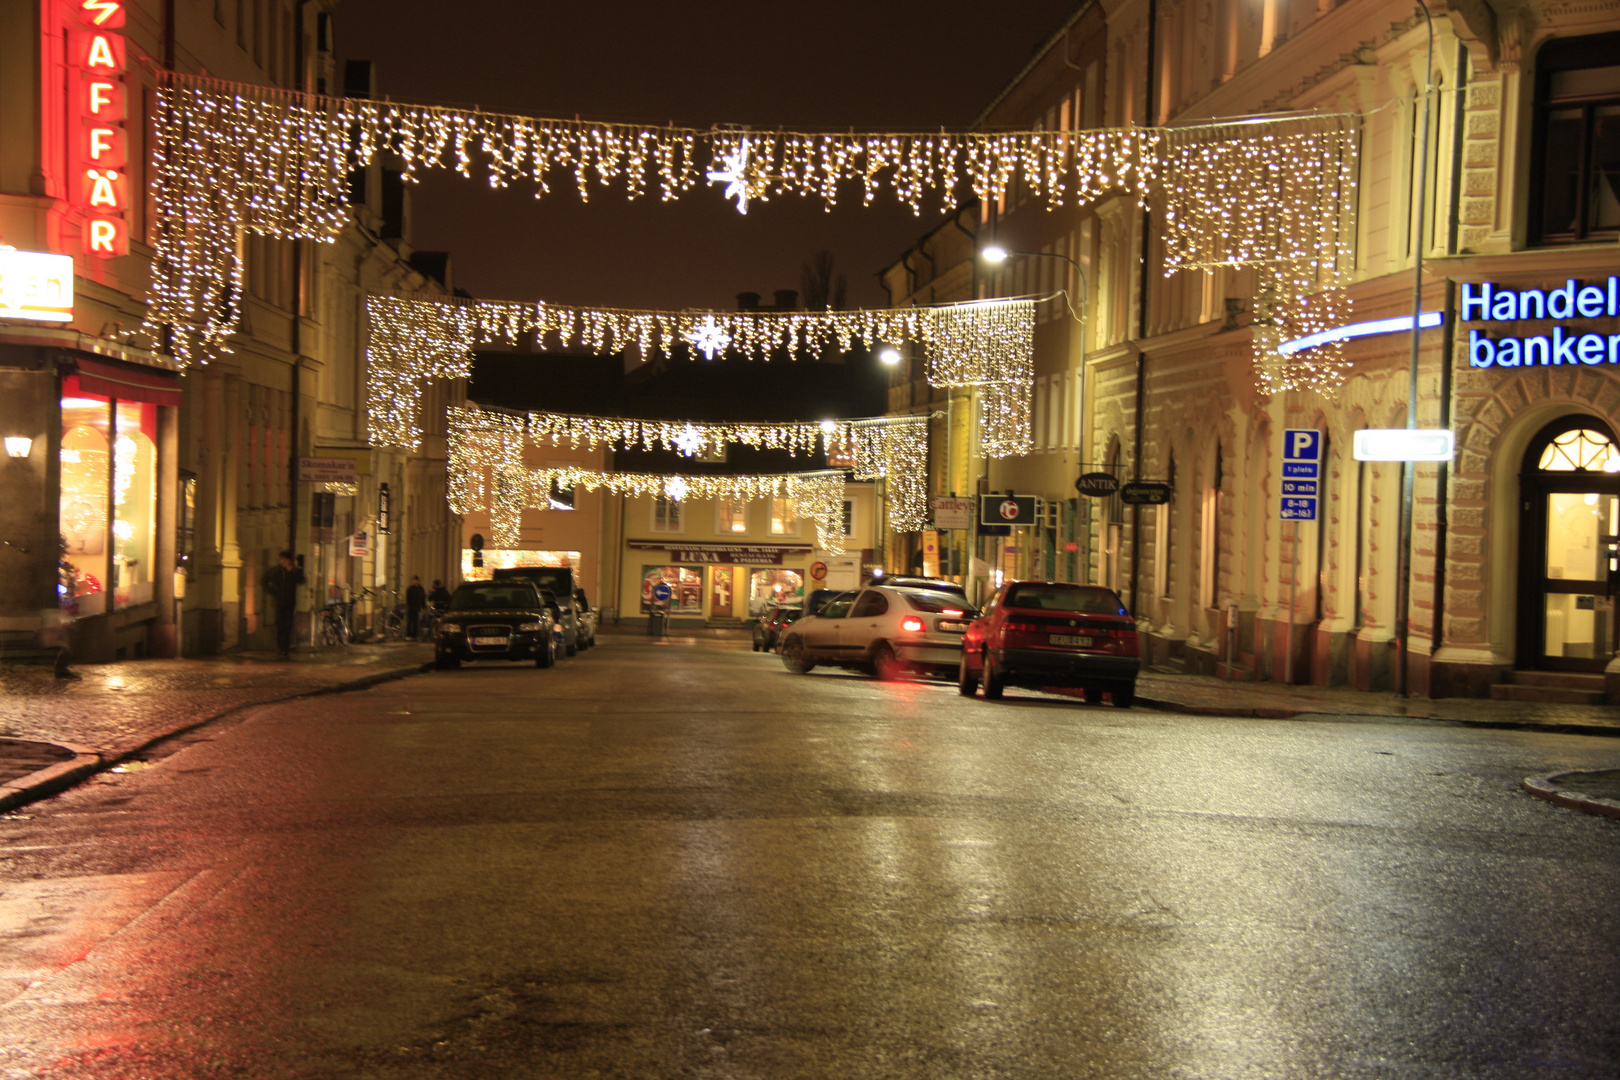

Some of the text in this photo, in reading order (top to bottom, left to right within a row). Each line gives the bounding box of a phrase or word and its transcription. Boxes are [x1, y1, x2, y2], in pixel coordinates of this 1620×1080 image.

[1461, 275, 1620, 321] Handel
[1293, 432, 1313, 458] P
[1079, 478, 1116, 490] ANTIK
[1284, 483, 1316, 492] 10 min
[680, 551, 720, 562] LUNA
